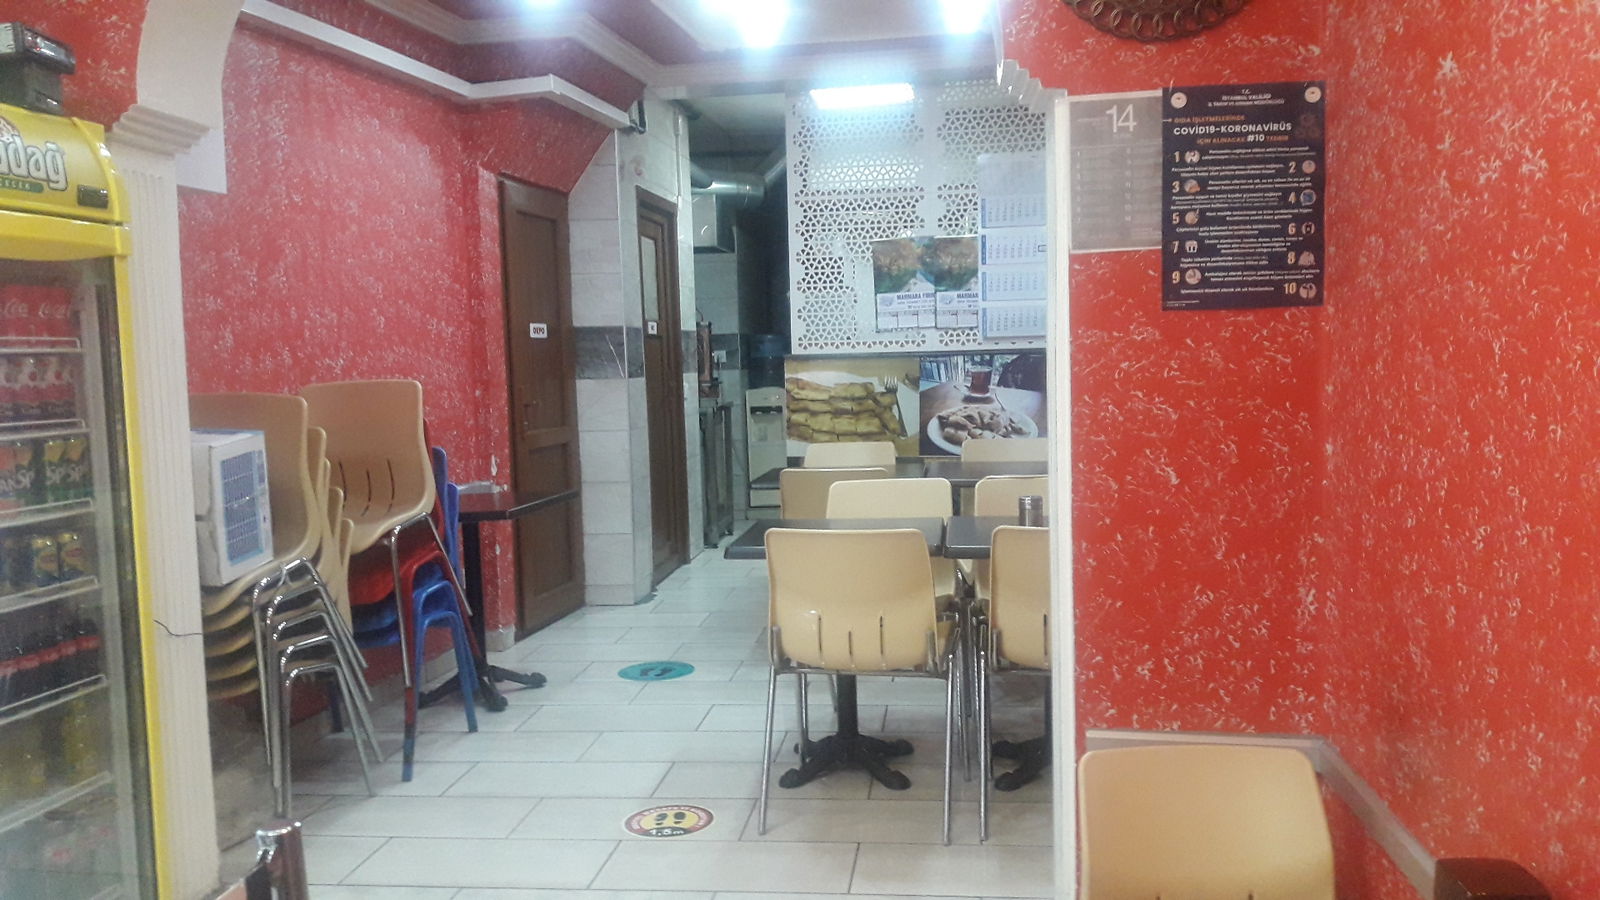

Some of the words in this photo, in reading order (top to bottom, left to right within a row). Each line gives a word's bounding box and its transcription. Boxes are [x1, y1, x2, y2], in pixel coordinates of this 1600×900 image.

[1105, 104, 1137, 133] 14
[1247, 134, 1265, 142] #10
[1174, 151, 1180, 163] 1
[1289, 161, 1296, 173] 2
[1172, 181, 1180, 193] 3
[1288, 191, 1296, 204] 4
[1172, 212, 1180, 224] 5
[1288, 222, 1296, 235] 6
[1172, 240, 1179, 253] 7
[1287, 251, 1296, 264] 8
[1172, 271, 1180, 284] 9
[1283, 282, 1297, 294] 10
[532, 327, 545, 335] DEPO
